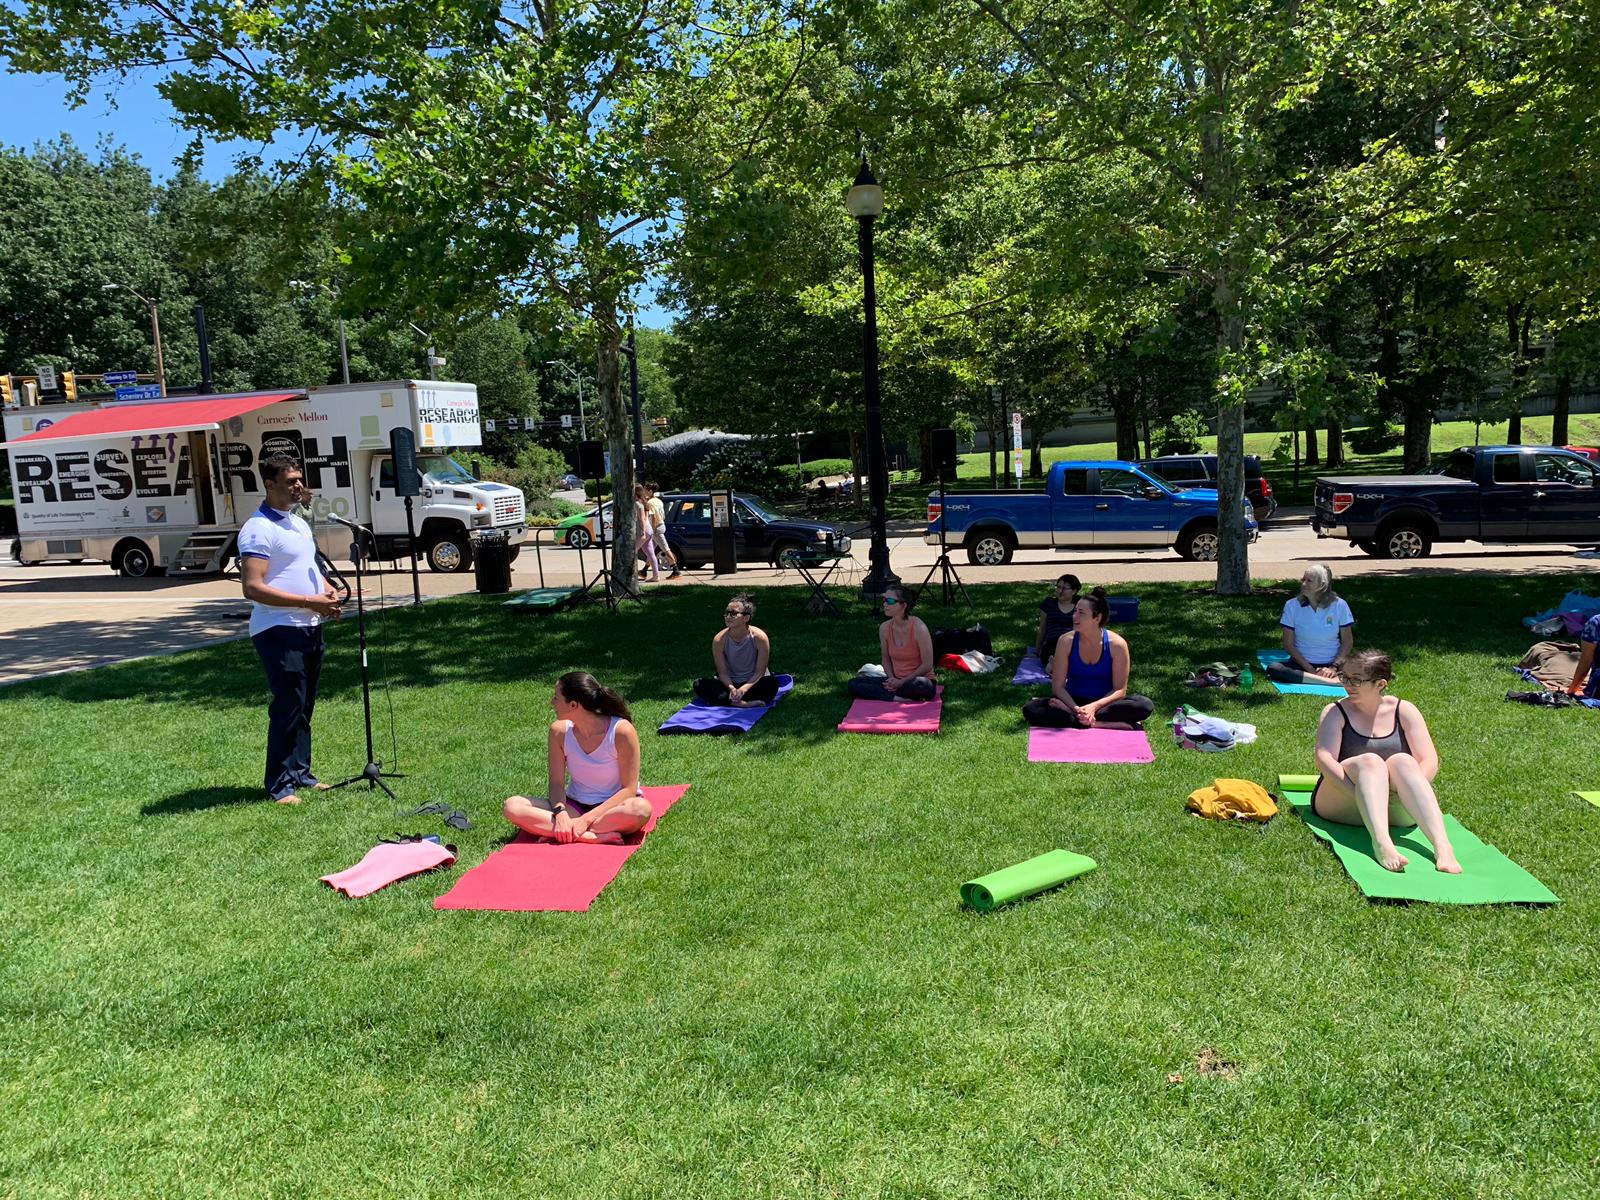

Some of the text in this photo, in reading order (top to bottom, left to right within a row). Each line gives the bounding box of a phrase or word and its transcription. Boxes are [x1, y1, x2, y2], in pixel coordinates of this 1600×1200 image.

[257, 411, 328, 424] Carnegie Mellon
[419, 408, 480, 423] RESEARCH
[96, 453, 124, 461] SURVEY
[136, 453, 164, 461] EXPLORE
[313, 497, 349, 518] GO
